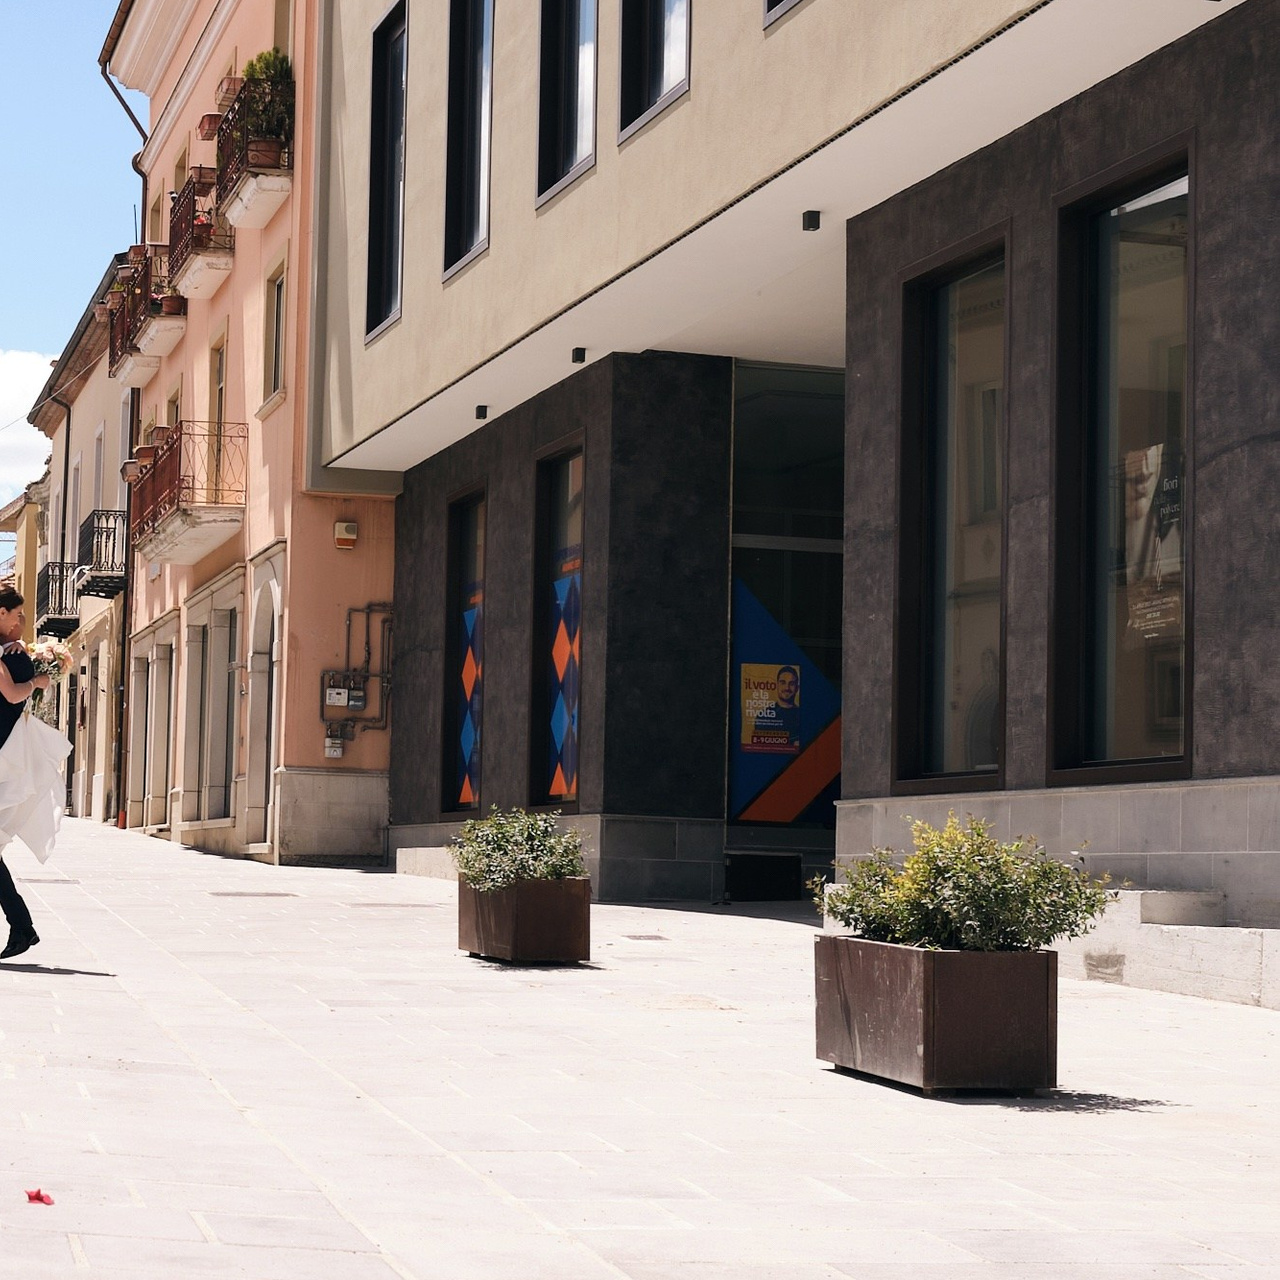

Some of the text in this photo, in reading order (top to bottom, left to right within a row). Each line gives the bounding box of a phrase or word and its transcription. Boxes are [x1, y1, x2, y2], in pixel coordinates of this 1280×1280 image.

[752, 680, 777, 691] voto
[760, 690, 769, 700] la
[746, 699, 776, 709] nostra
[746, 707, 776, 718] rivolta
[764, 736, 788, 745] GIUGNO
